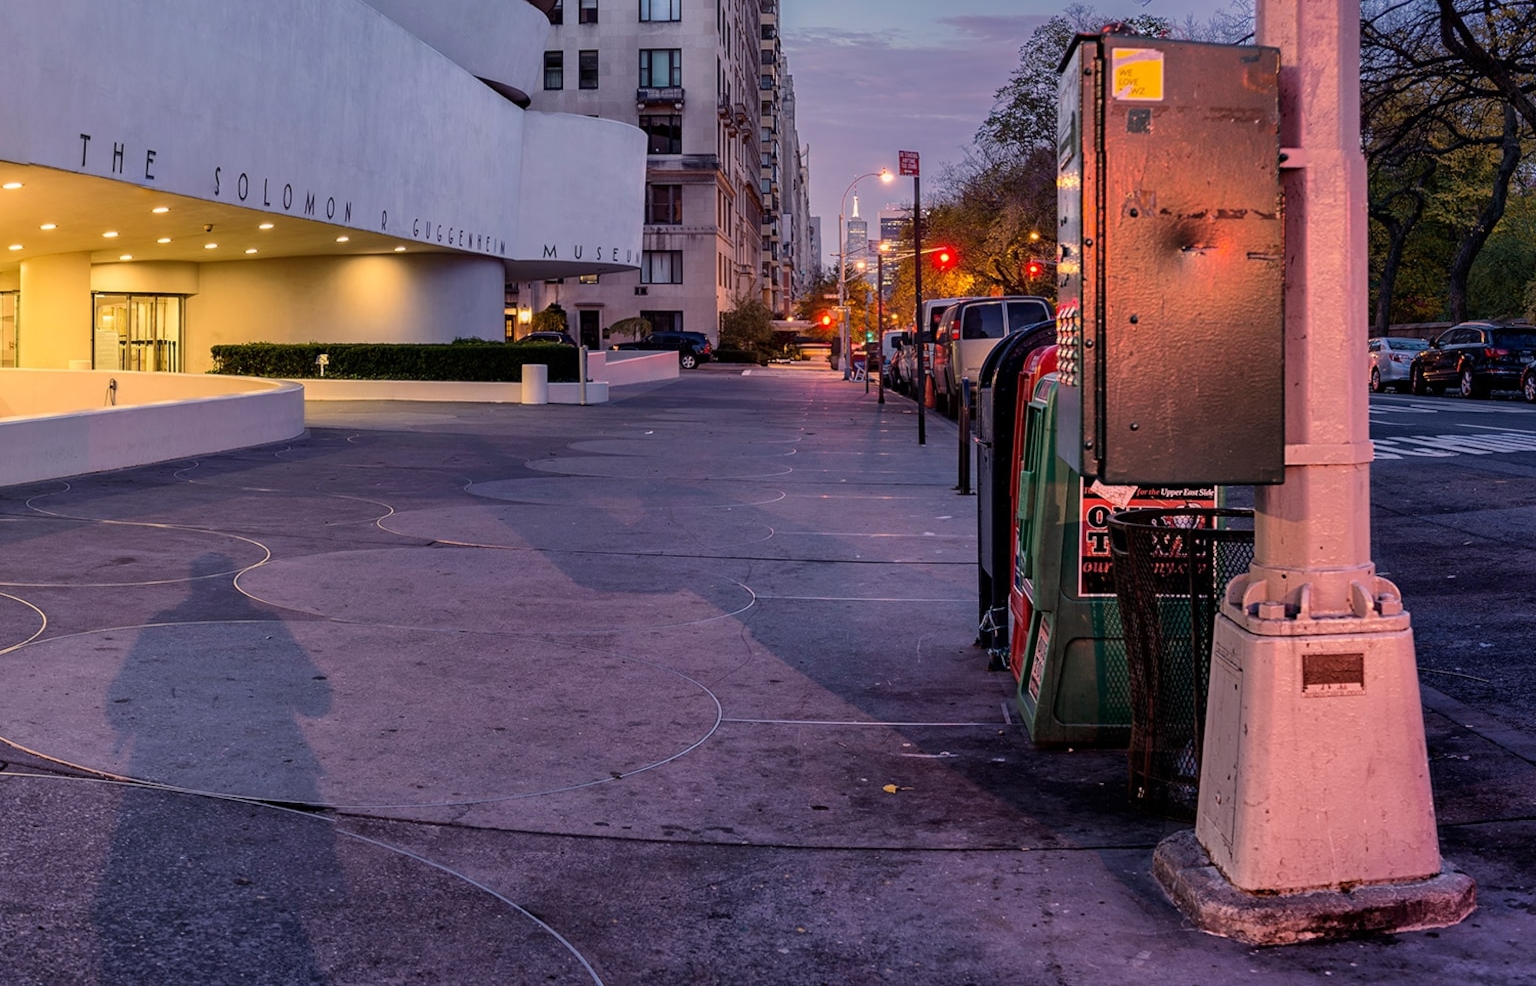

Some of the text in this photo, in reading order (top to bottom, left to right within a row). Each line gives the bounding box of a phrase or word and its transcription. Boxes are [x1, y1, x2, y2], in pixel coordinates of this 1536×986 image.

[80, 133, 157, 180] THE
[214, 166, 352, 223] SOLOMON
[413, 218, 506, 255] GUGGENHEIM
[1149, 488, 1160, 496] the
[1160, 488, 1183, 498] Upper
[1183, 488, 1199, 497] East
[1199, 488, 1214, 498] Side
